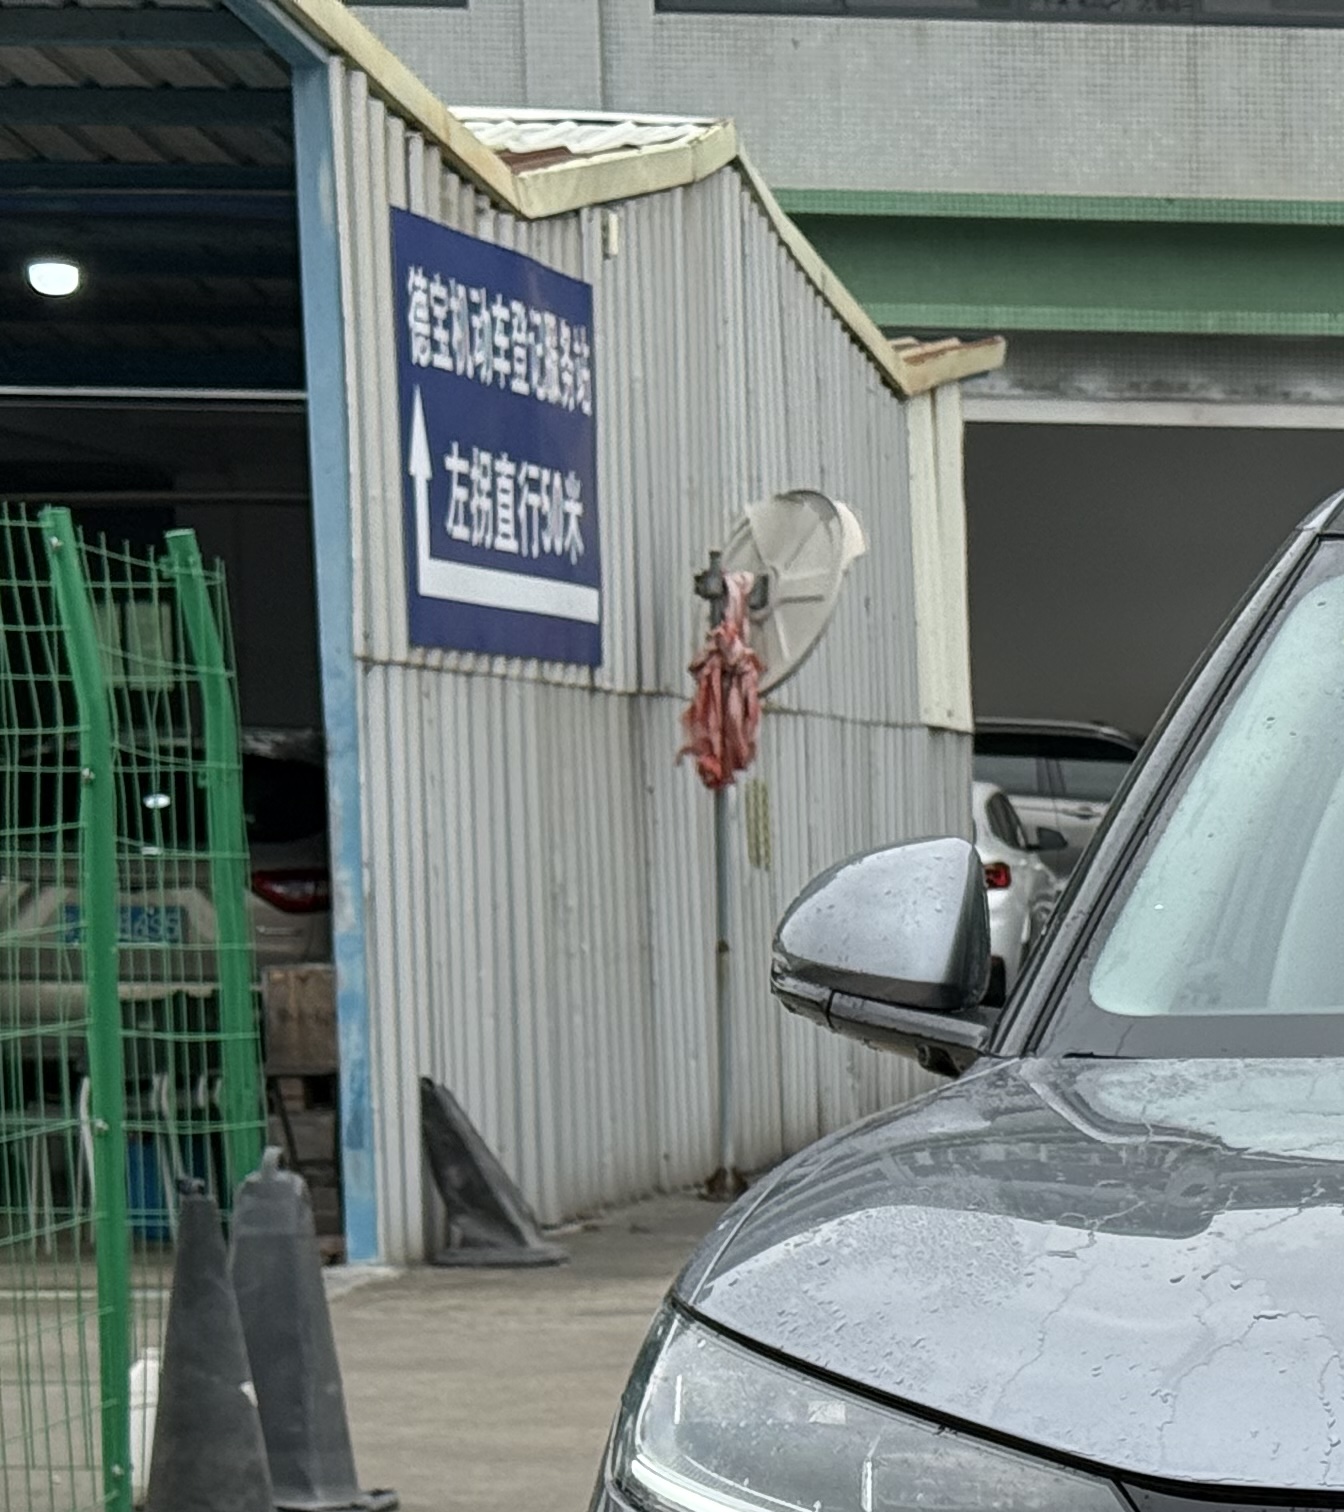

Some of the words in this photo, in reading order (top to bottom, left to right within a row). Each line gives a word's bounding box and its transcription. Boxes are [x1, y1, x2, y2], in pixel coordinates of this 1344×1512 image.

[408, 265, 592, 417] 德宝机动车登记服务站
[444, 441, 584, 565] 左拐直行50米
